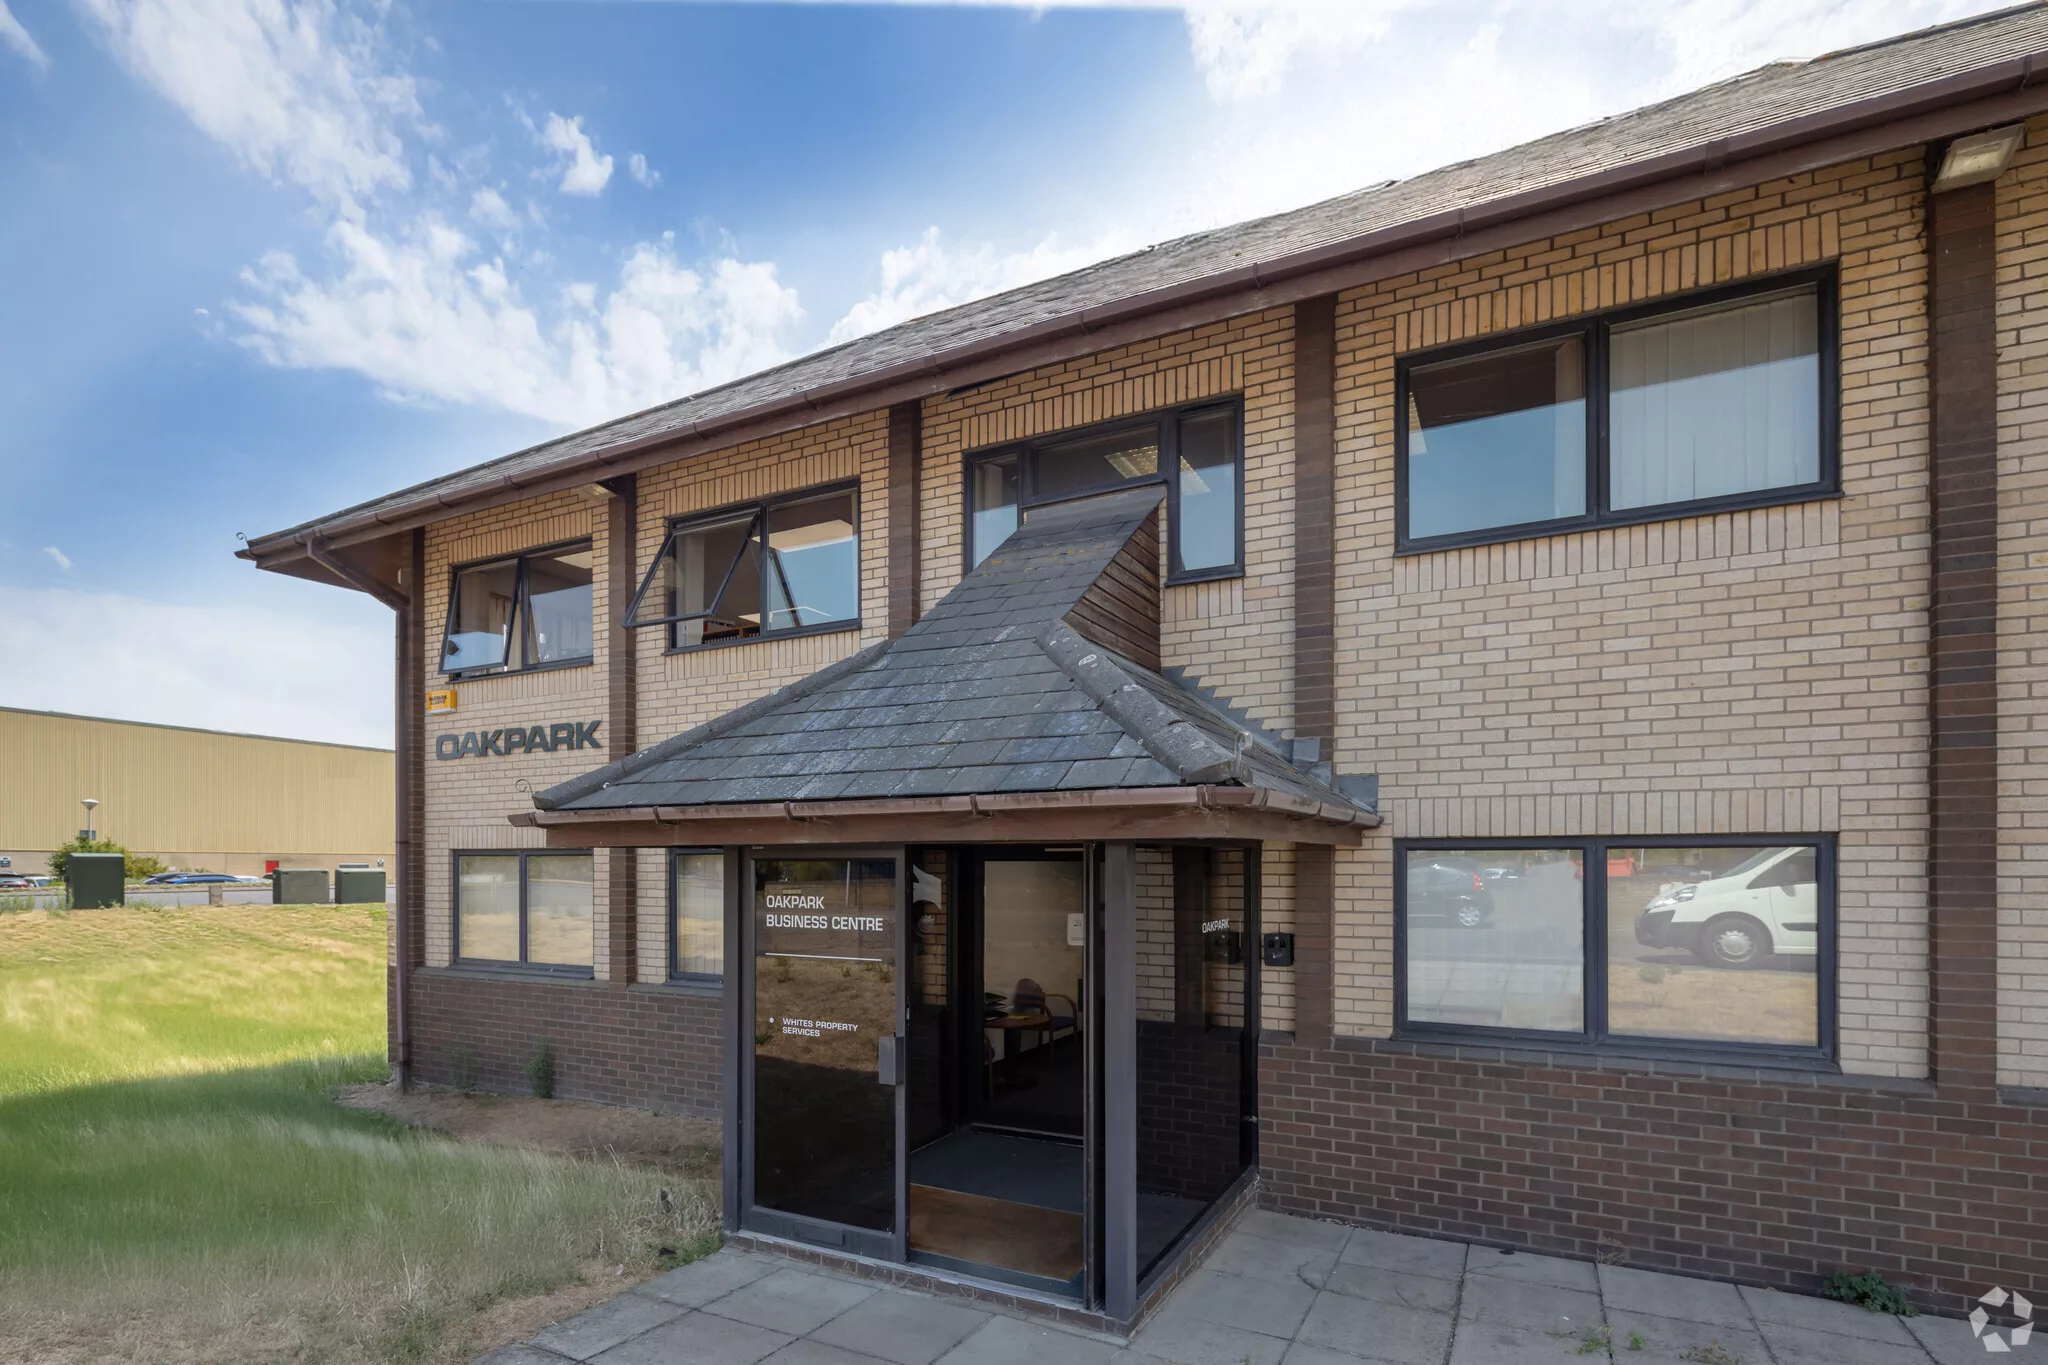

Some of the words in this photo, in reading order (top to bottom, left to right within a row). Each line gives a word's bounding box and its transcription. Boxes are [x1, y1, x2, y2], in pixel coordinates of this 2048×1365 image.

[435, 719, 603, 761] OAKPARK
[766, 895, 825, 909] OAKPARK
[766, 914, 828, 930] BUSINESS
[831, 916, 884, 932] CENTRE
[1202, 918, 1230, 934] OAKPARK
[782, 1017, 813, 1028] WHITES
[815, 1021, 859, 1032] PROPERTY
[782, 1026, 821, 1037] SERVICES
